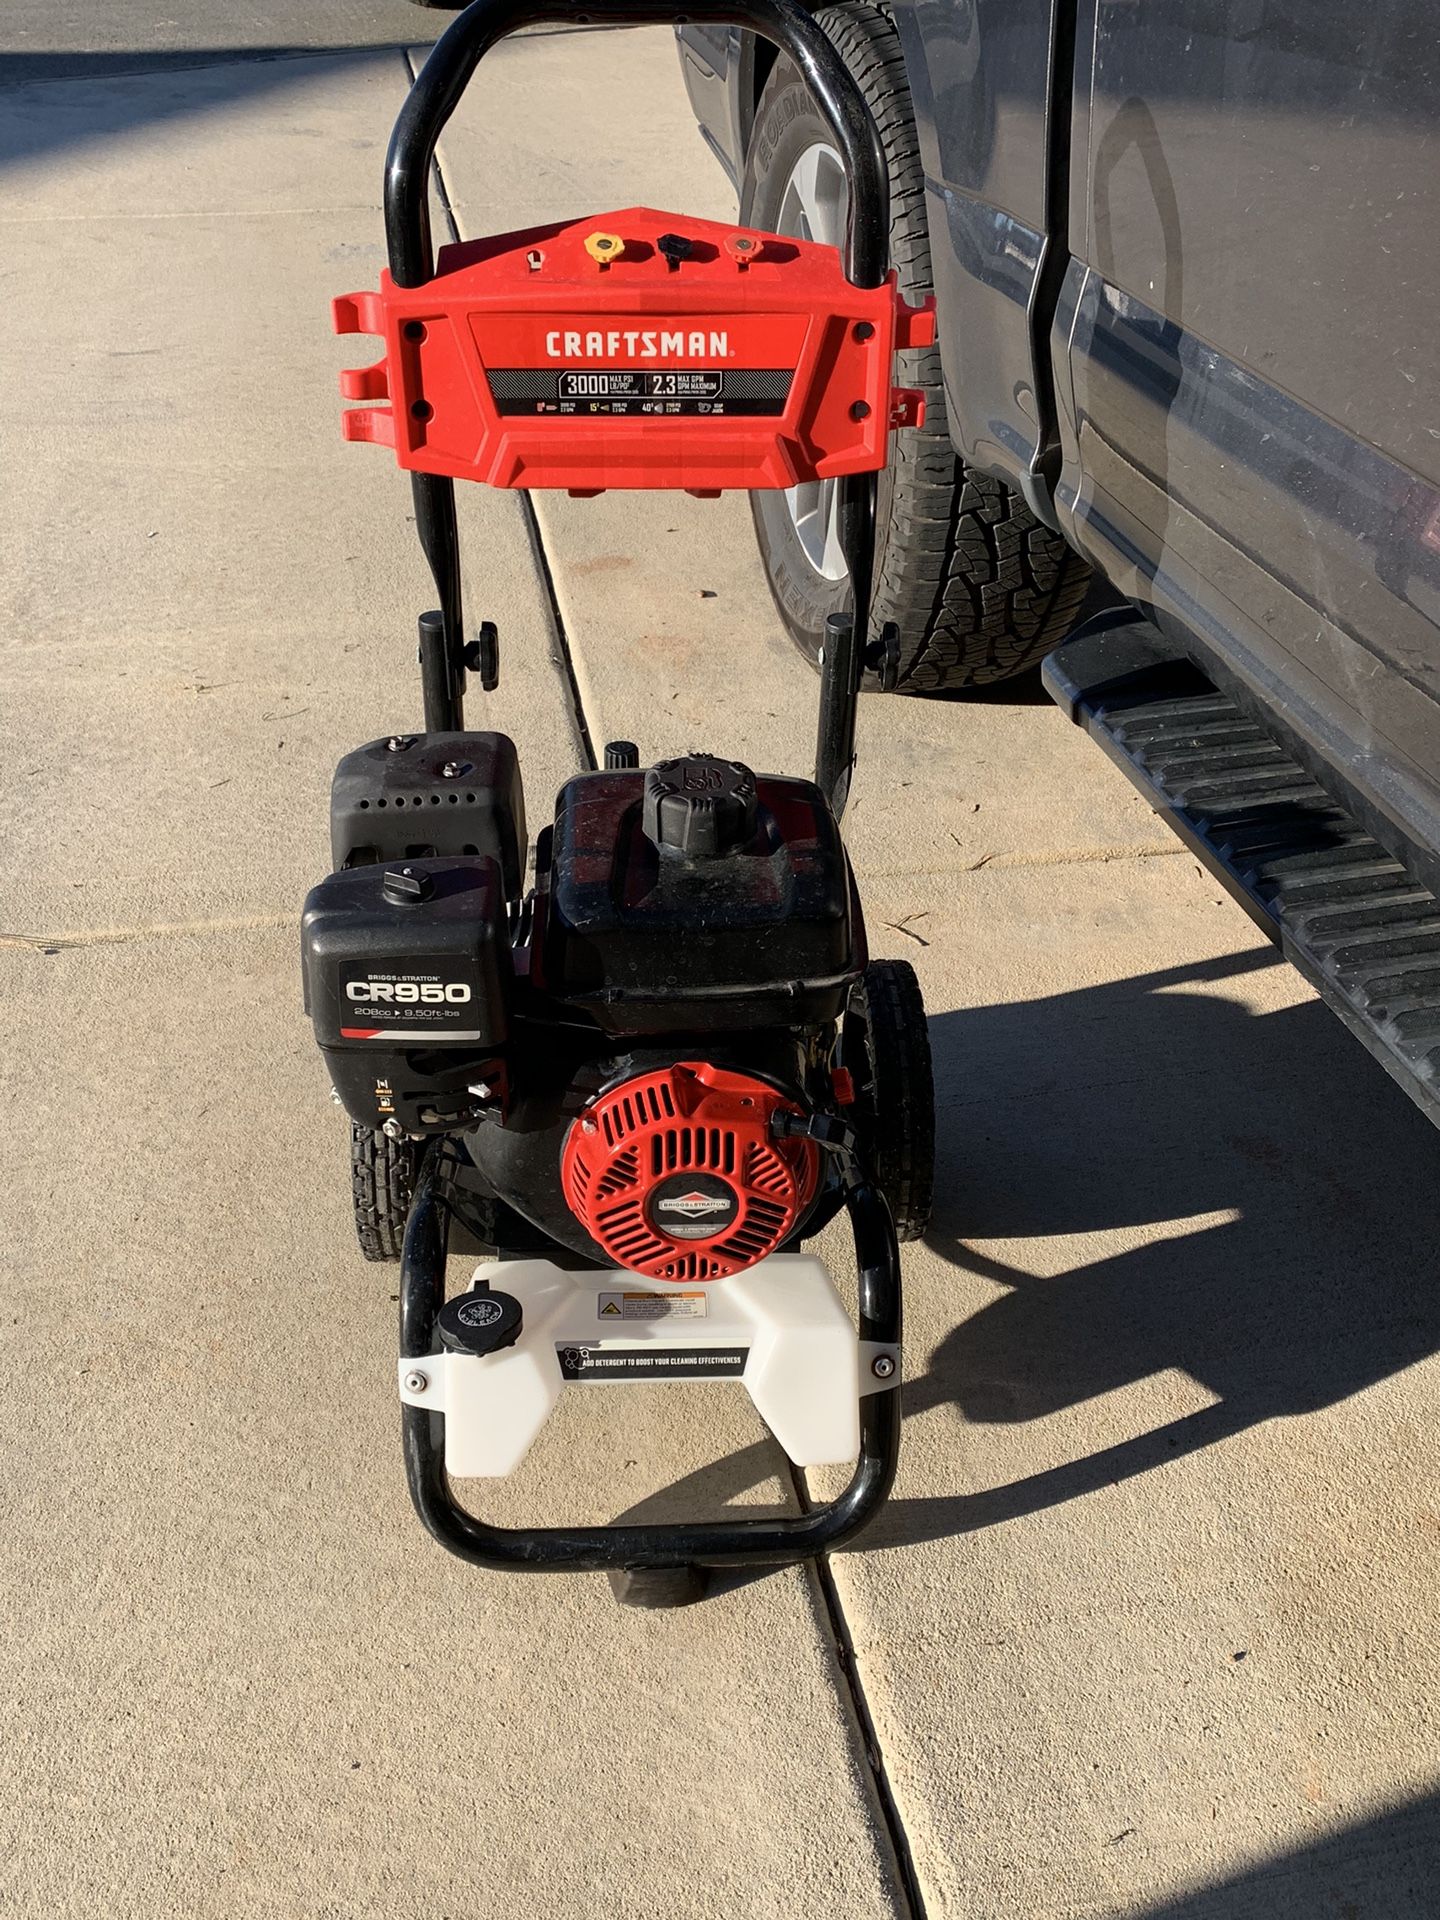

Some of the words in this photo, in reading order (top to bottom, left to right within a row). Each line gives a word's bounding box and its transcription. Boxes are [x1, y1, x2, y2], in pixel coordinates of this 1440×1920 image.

[546, 331, 728, 358] CRAFTSMAN
[609, 375, 622, 383] MAX
[623, 375, 634, 383] PSI
[677, 375, 690, 383] MAX
[691, 375, 704, 383] GPM
[567, 375, 609, 395] 3000
[653, 375, 676, 395] 2.3
[691, 382, 717, 390] MAXIMUM
[345, 981, 472, 1003] CR950
[354, 1007, 391, 1016] 208cc
[582, 1359, 595, 1367] ADD
[595, 1359, 627, 1367] DETERGENT
[636, 1358, 653, 1366] BOOST
[655, 1357, 670, 1365] YOUR
[670, 1357, 698, 1365] CLEANING
[698, 1356, 741, 1365] EFFECTIVENESS
